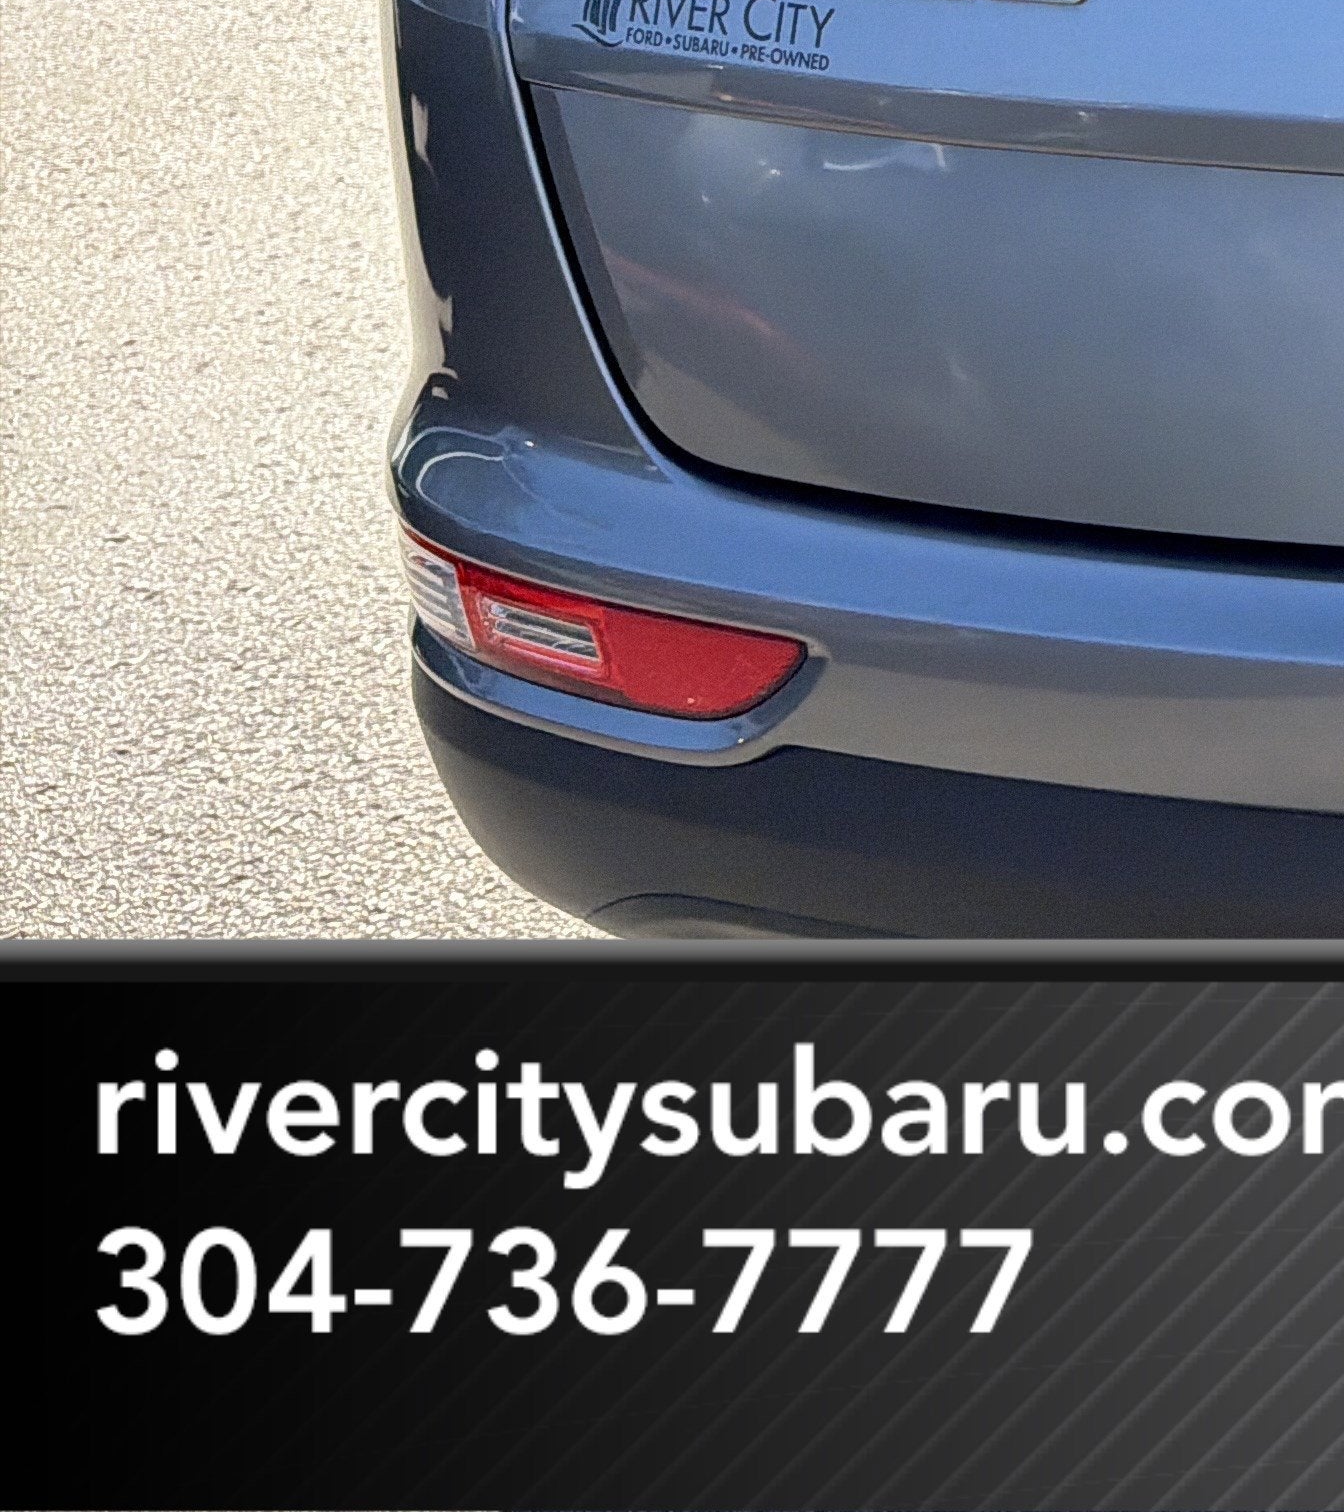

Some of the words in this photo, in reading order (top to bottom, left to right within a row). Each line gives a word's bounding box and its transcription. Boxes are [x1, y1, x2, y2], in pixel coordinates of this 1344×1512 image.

[625, 26, 664, 48] FORD
[672, 33, 730, 58] SUBARU
[739, 44, 830, 72] PRE-OWNED
